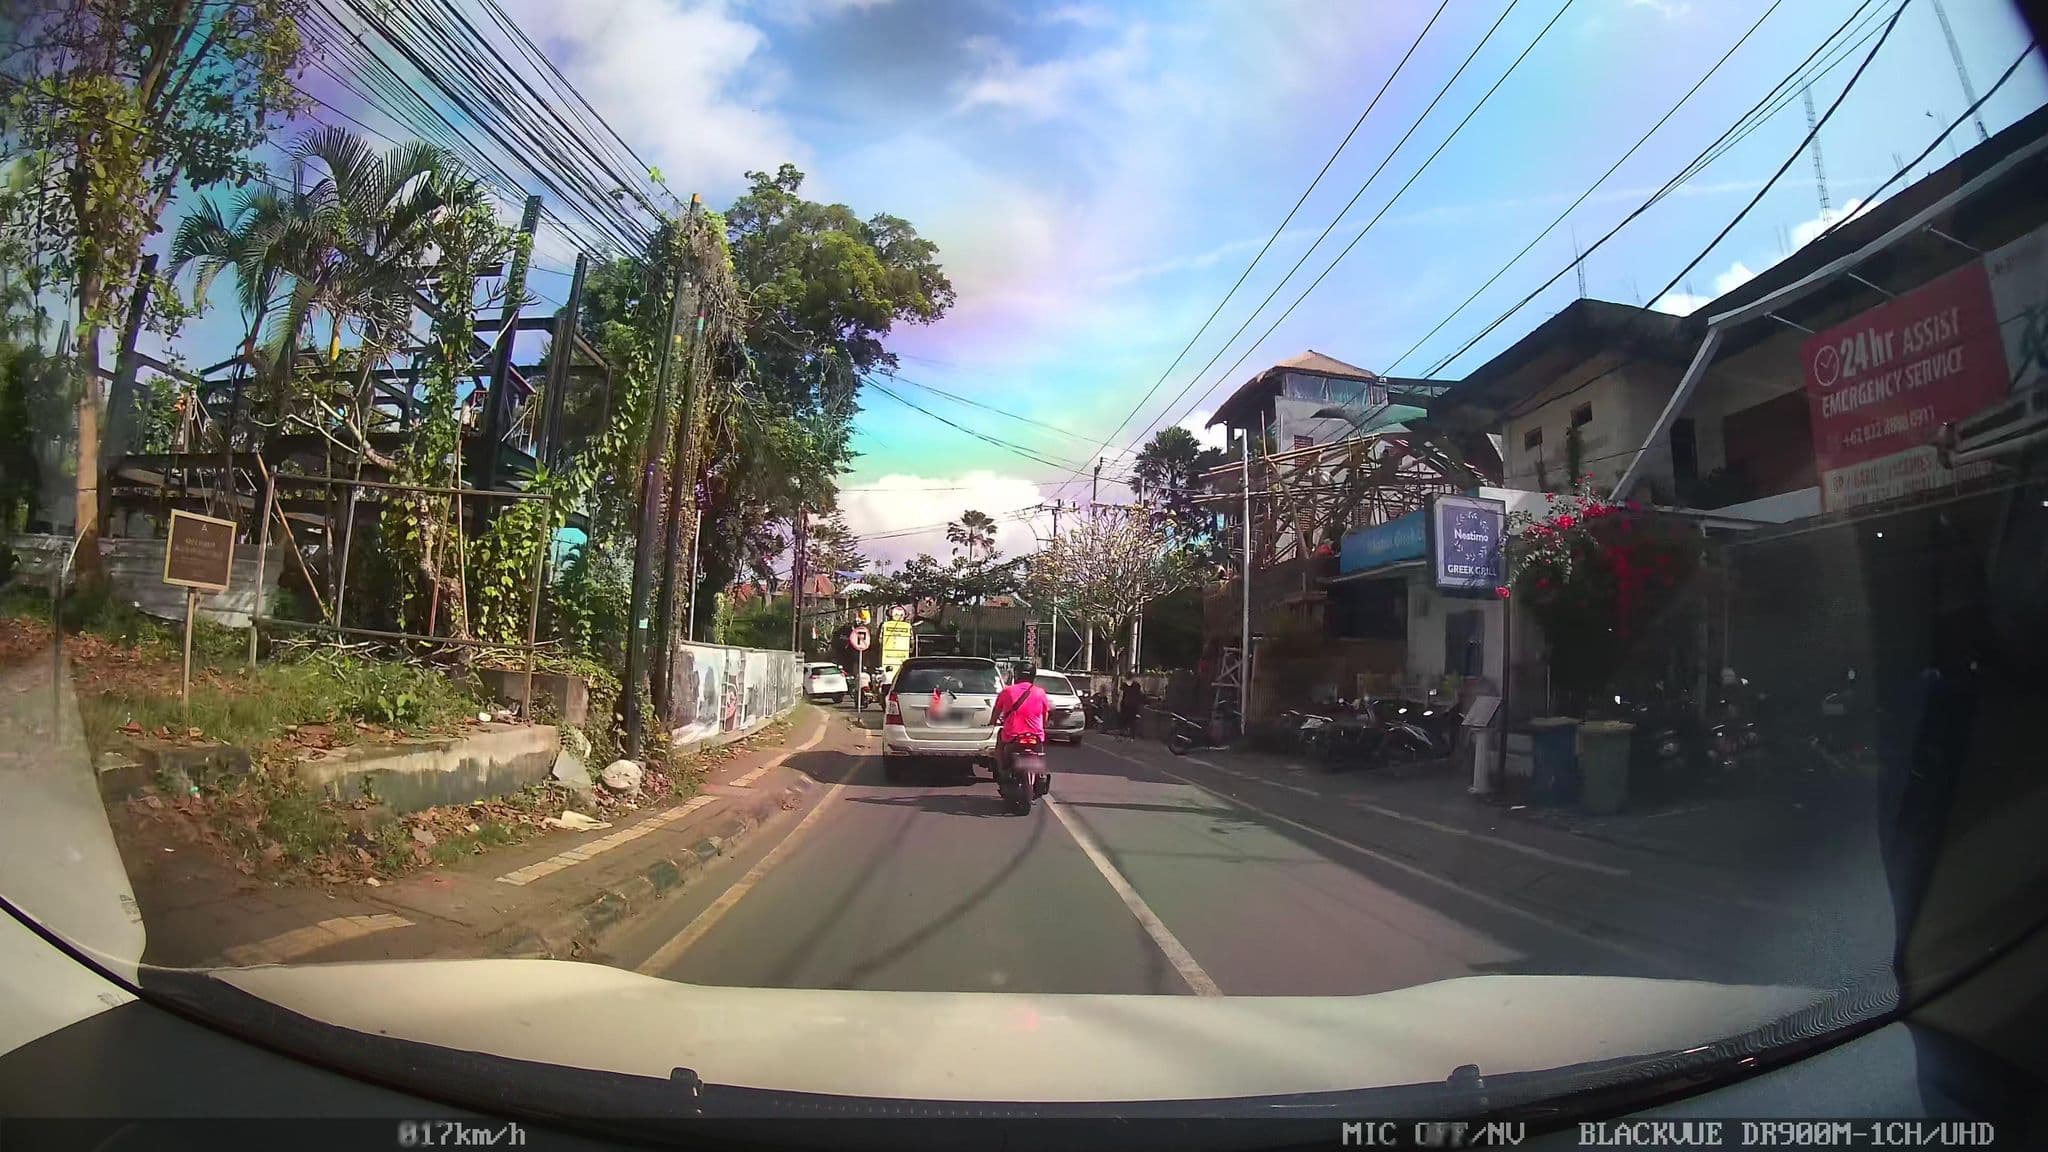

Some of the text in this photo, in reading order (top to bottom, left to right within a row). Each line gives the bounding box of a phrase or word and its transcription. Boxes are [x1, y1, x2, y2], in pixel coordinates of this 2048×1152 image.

[1903, 307, 1960, 355] ASSIST
[1822, 345, 1965, 418] EMERGENCY SERVICE
[1448, 565, 1474, 574] GREEK
